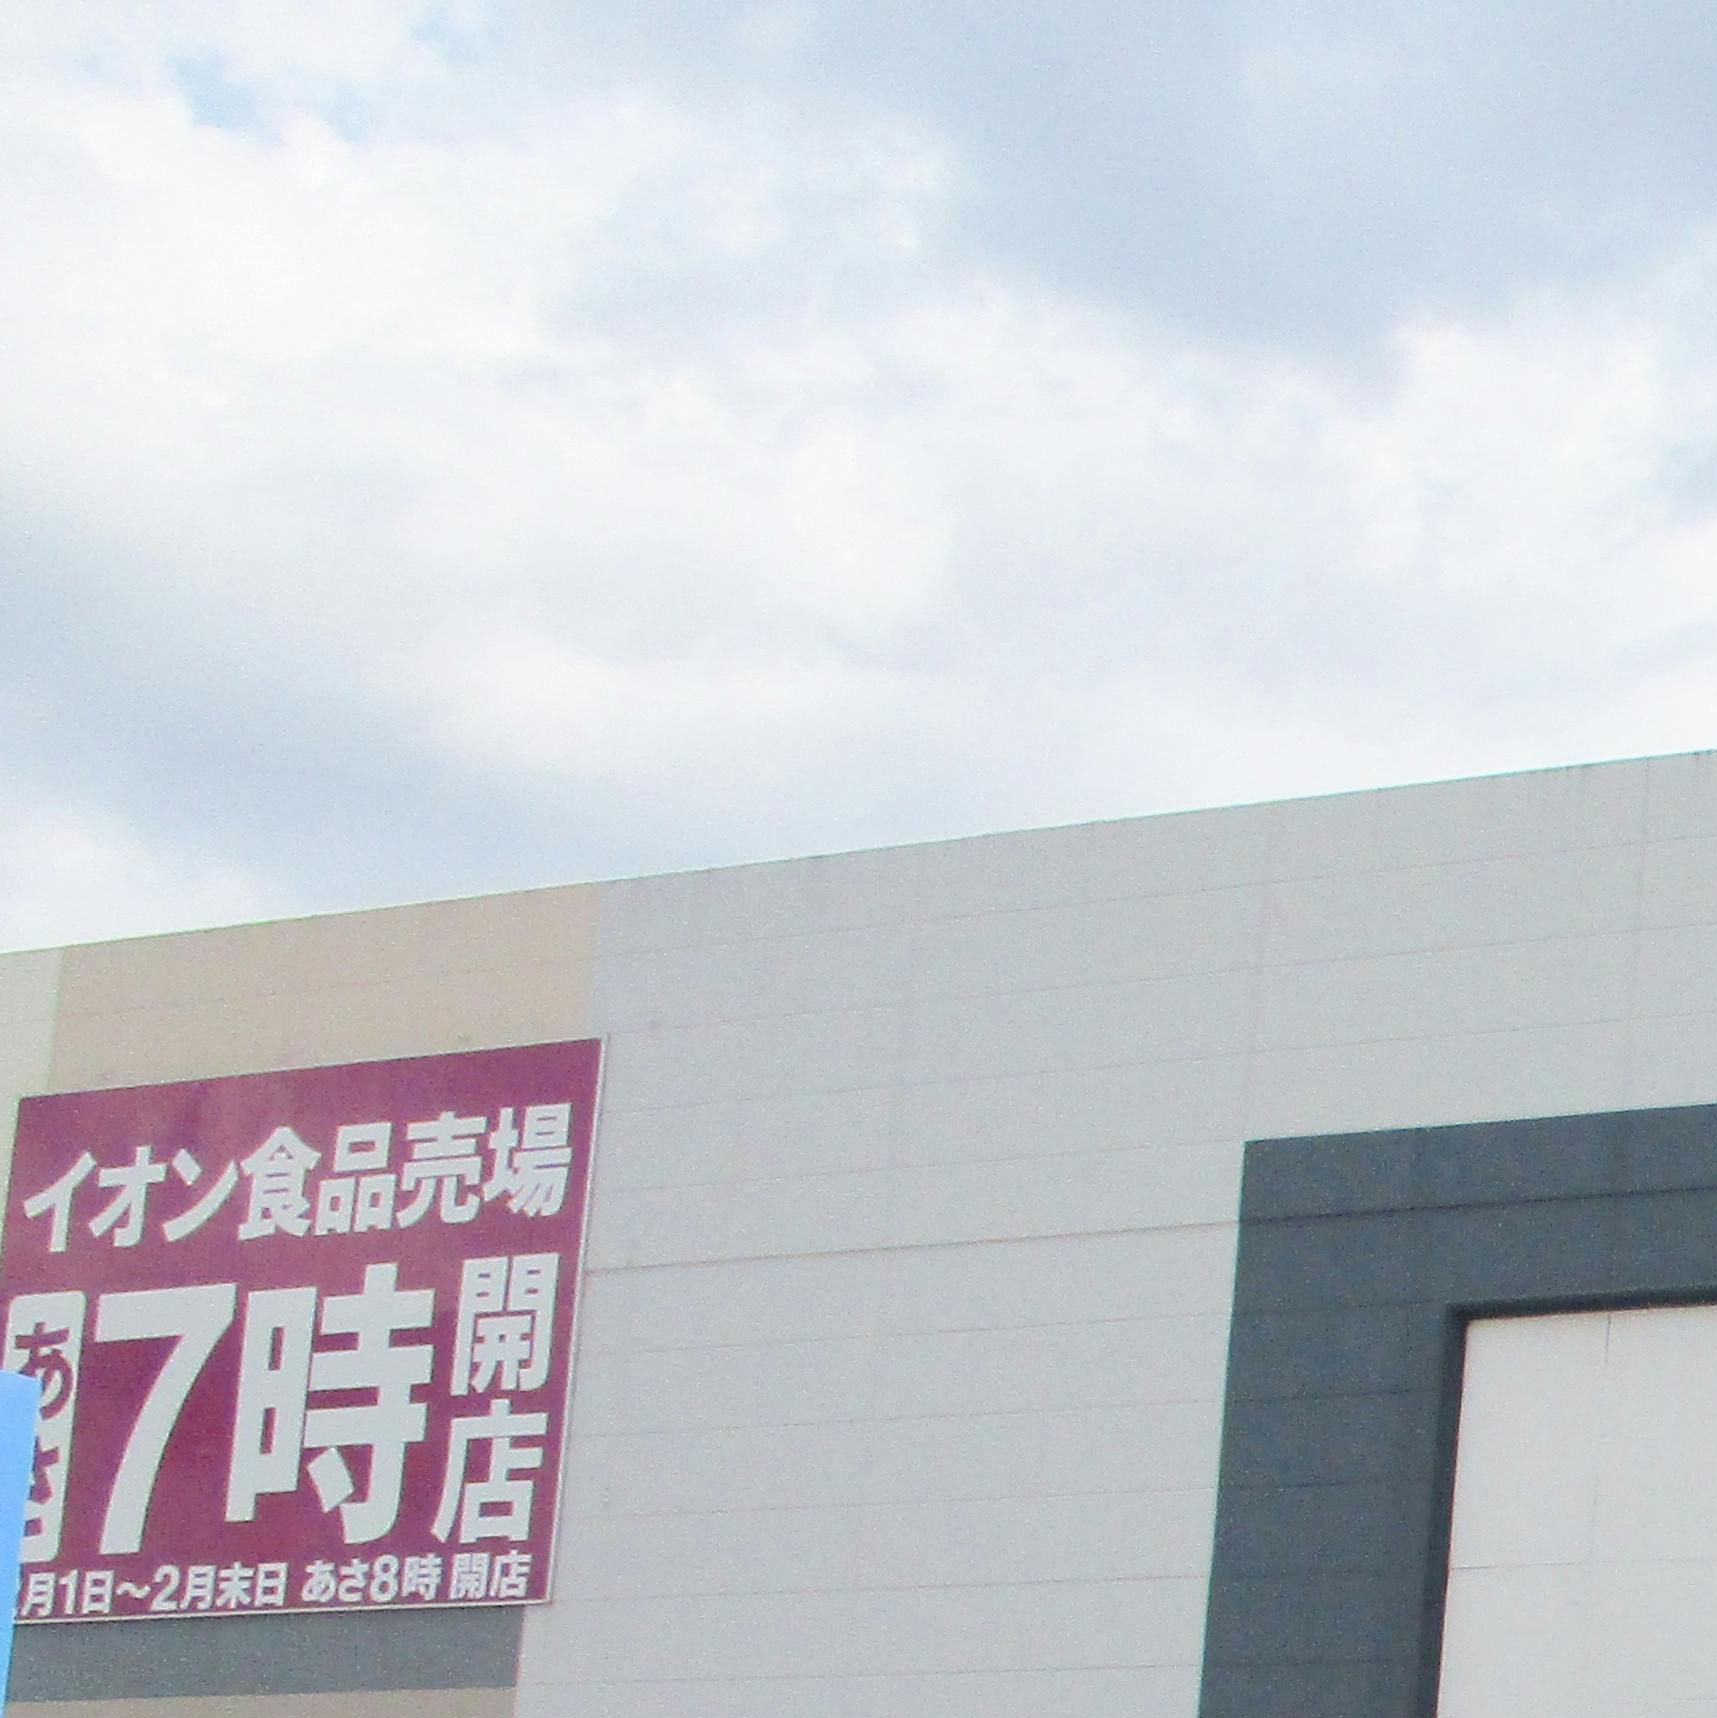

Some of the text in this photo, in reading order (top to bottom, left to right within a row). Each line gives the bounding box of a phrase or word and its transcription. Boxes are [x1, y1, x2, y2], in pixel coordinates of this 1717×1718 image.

[23, 1102, 572, 1253] イオン食品売場
[430, 1252, 560, 1545] 開店
[300, 1553, 442, 1603] あさ8時
[449, 1549, 532, 1600] 開店
